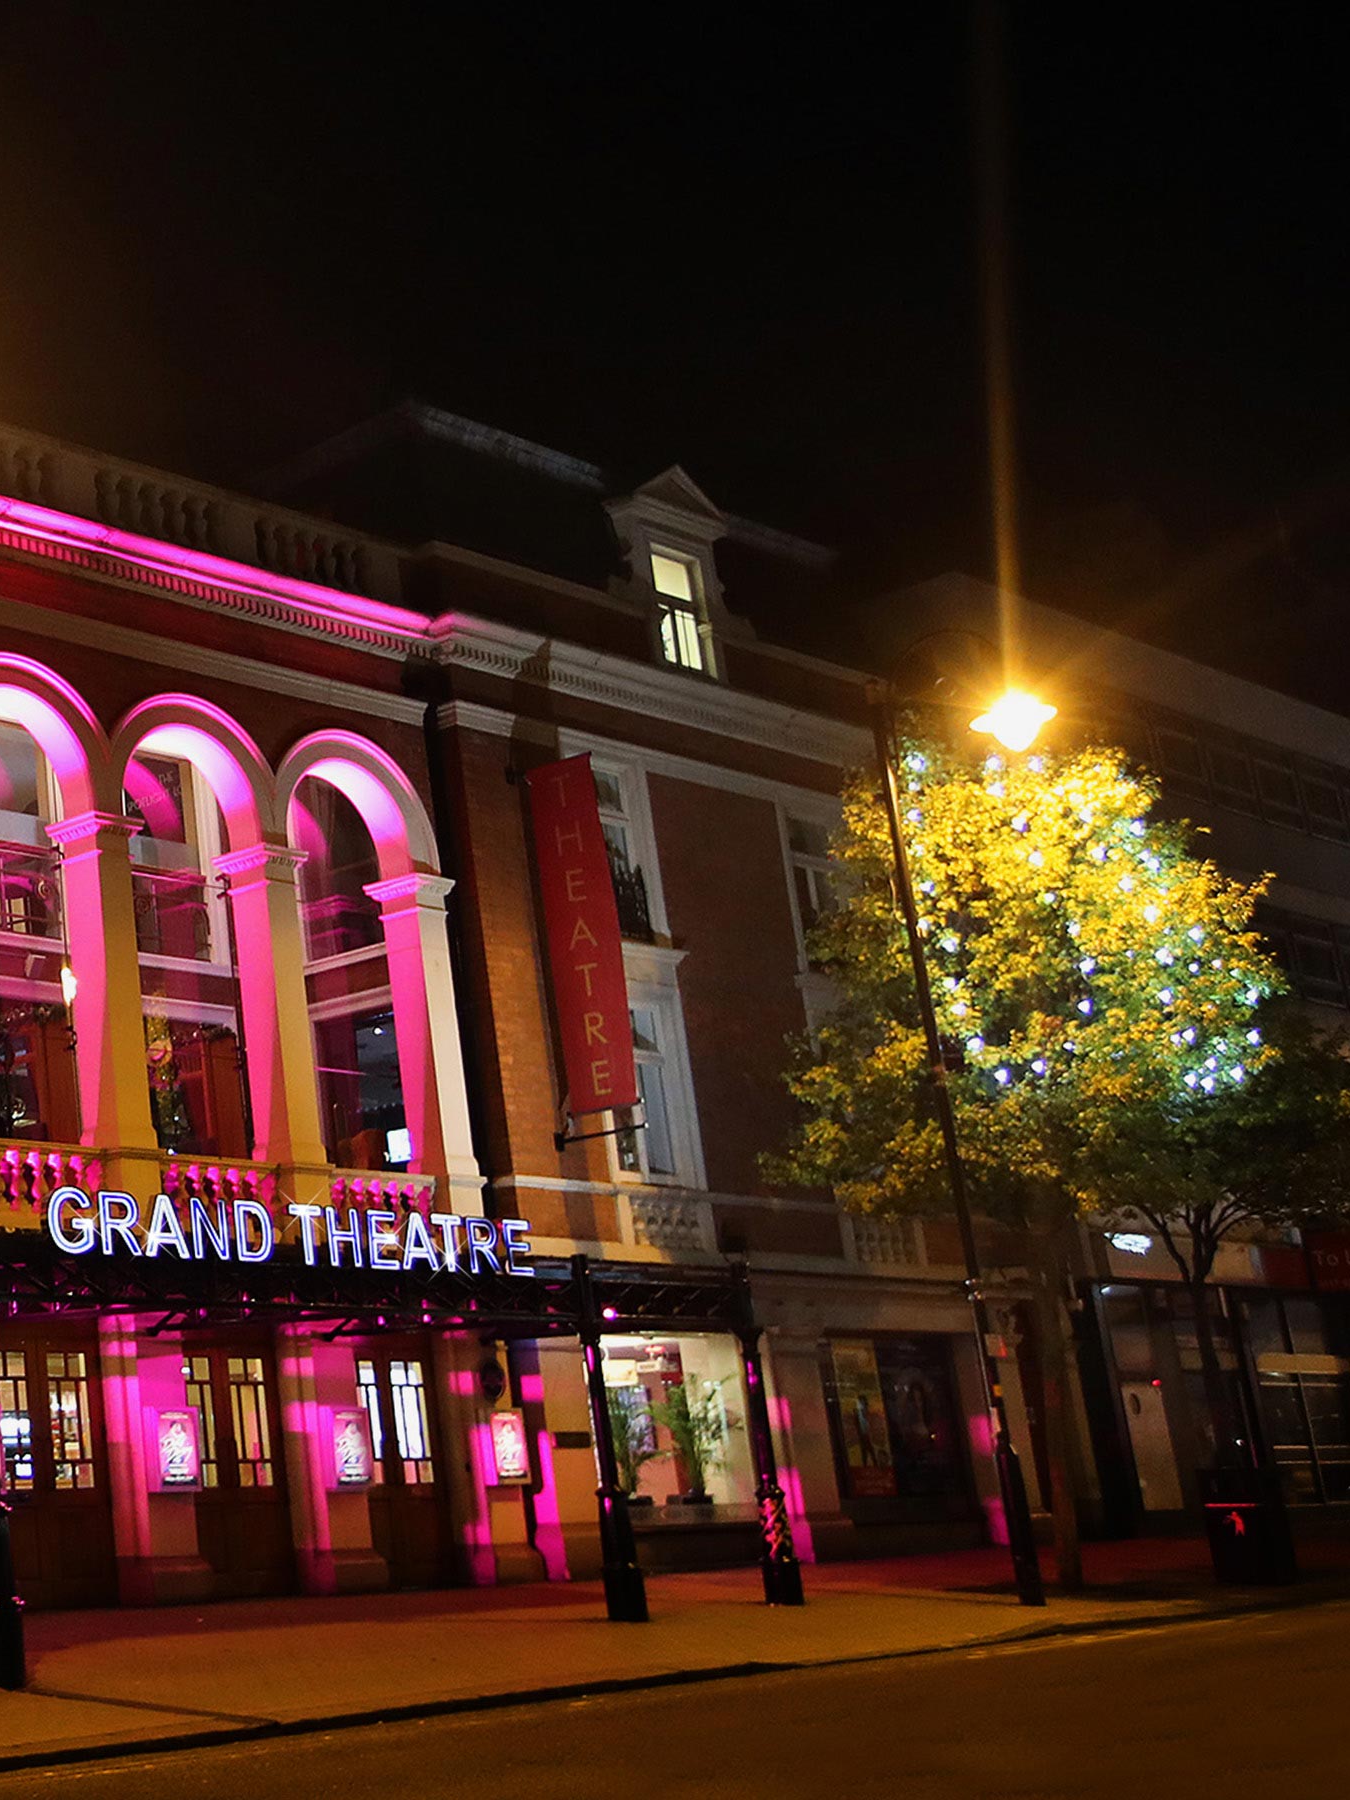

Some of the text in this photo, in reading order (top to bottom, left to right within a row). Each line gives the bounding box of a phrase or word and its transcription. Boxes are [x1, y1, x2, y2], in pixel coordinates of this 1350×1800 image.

[553, 776, 612, 1096] THEATRE
[47, 1185, 536, 1278] GRAND THEATRE
